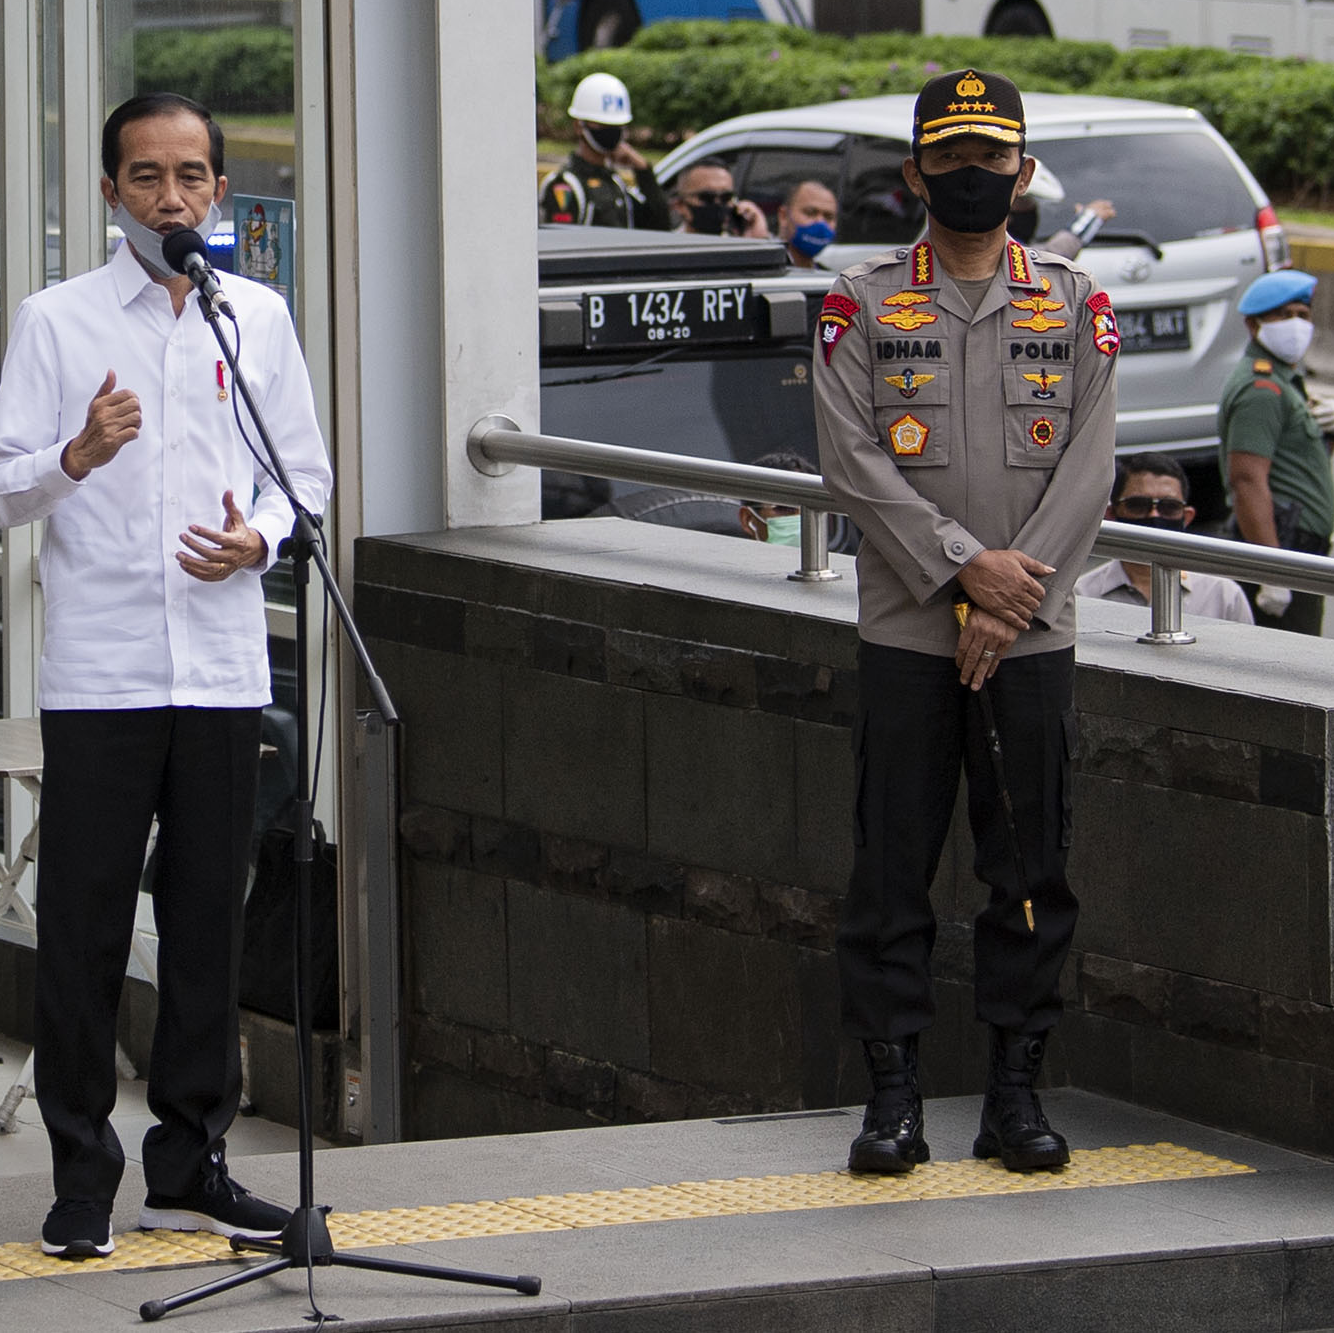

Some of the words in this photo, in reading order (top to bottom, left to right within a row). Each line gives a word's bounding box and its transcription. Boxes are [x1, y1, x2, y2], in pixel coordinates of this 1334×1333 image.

[589, 296, 605, 328] B
[628, 291, 686, 326] 1434
[703, 288, 747, 322] RFY
[876, 340, 942, 360] IDHAM
[1010, 341, 1070, 361] POLRI
